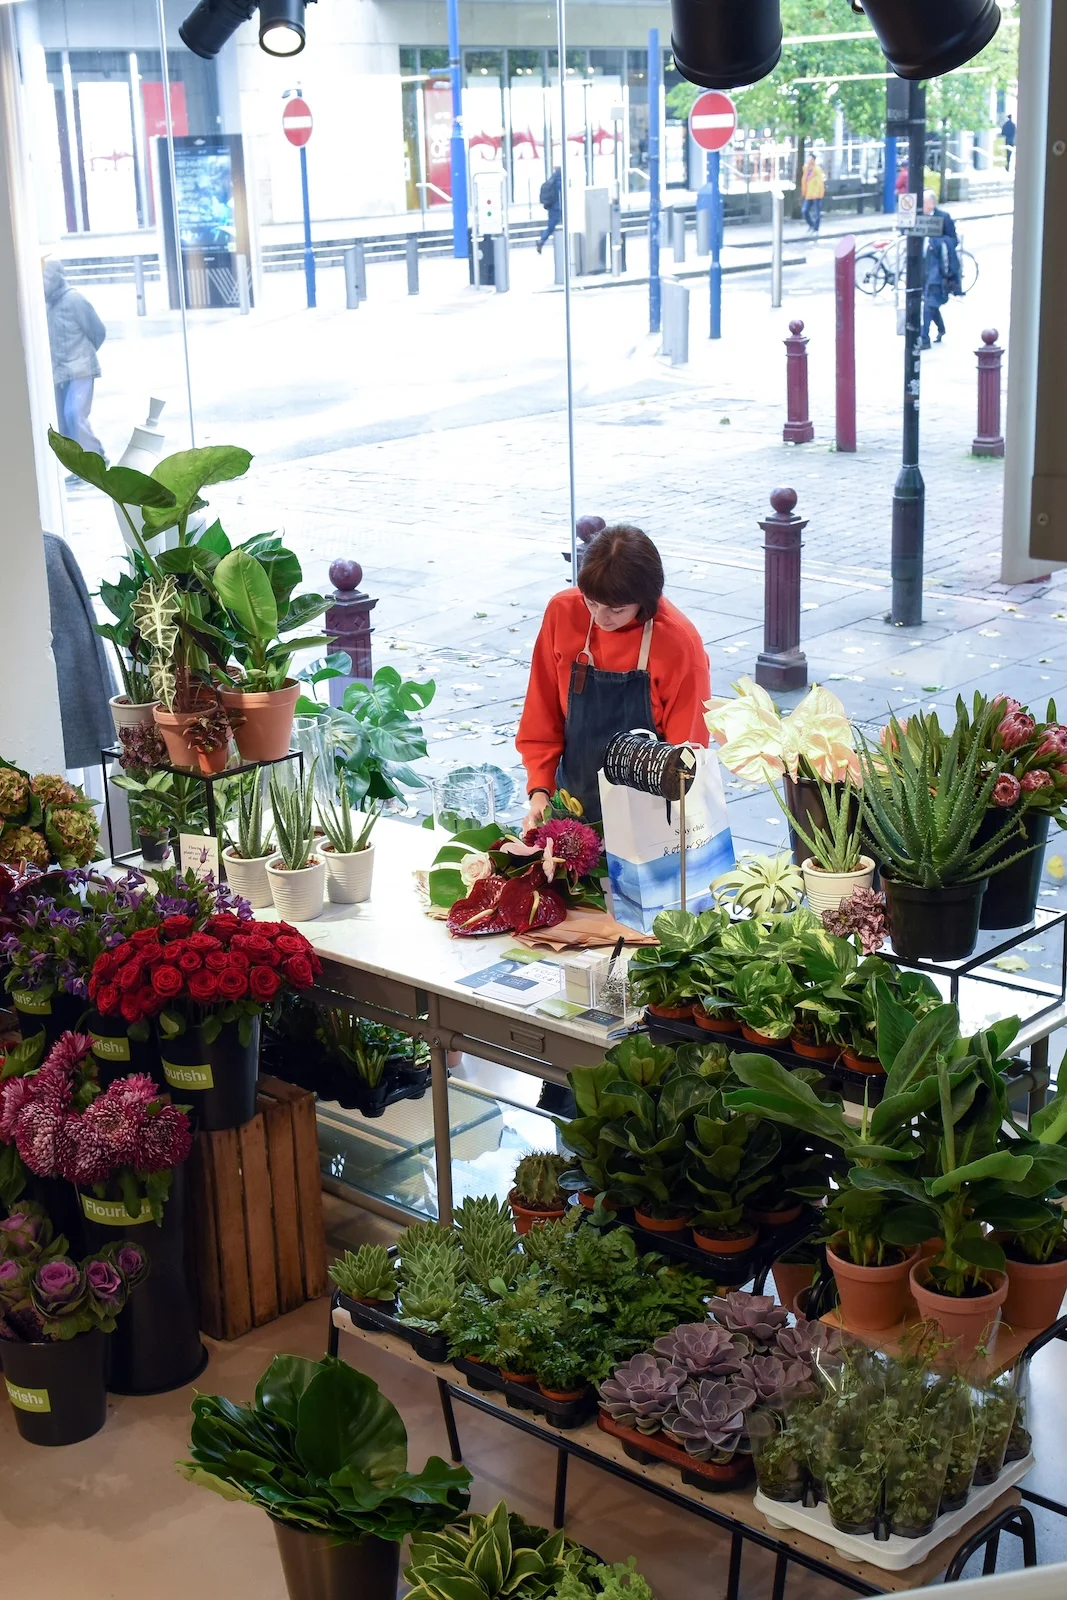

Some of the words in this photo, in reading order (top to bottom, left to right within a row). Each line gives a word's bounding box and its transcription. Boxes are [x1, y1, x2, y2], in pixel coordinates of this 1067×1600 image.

[675, 828, 690, 836] Sy
[164, 1067, 202, 1081] ourish
[85, 1199, 145, 1217] Flouri
